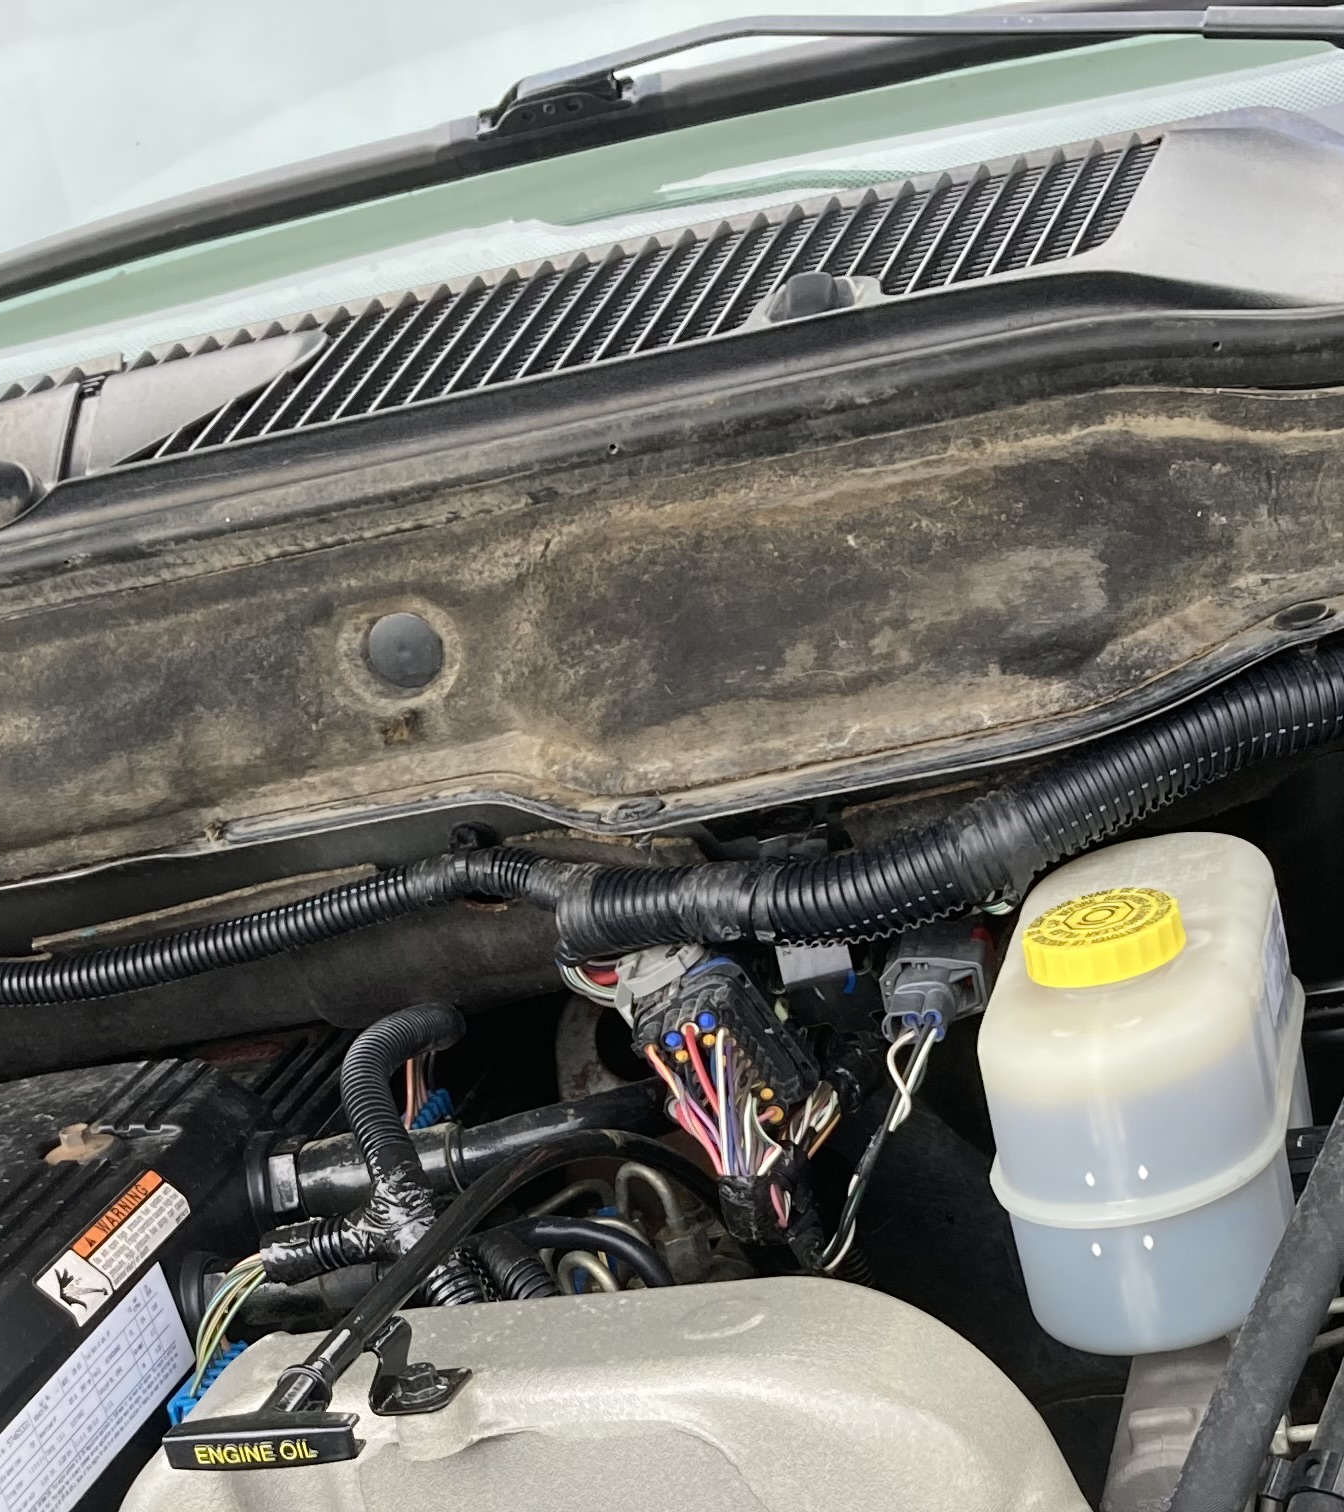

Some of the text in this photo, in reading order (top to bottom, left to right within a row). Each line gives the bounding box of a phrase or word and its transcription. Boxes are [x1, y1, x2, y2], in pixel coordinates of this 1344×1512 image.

[95, 1184, 148, 1234] WARNING
[194, 1438, 319, 1465] ENGINE OIL
